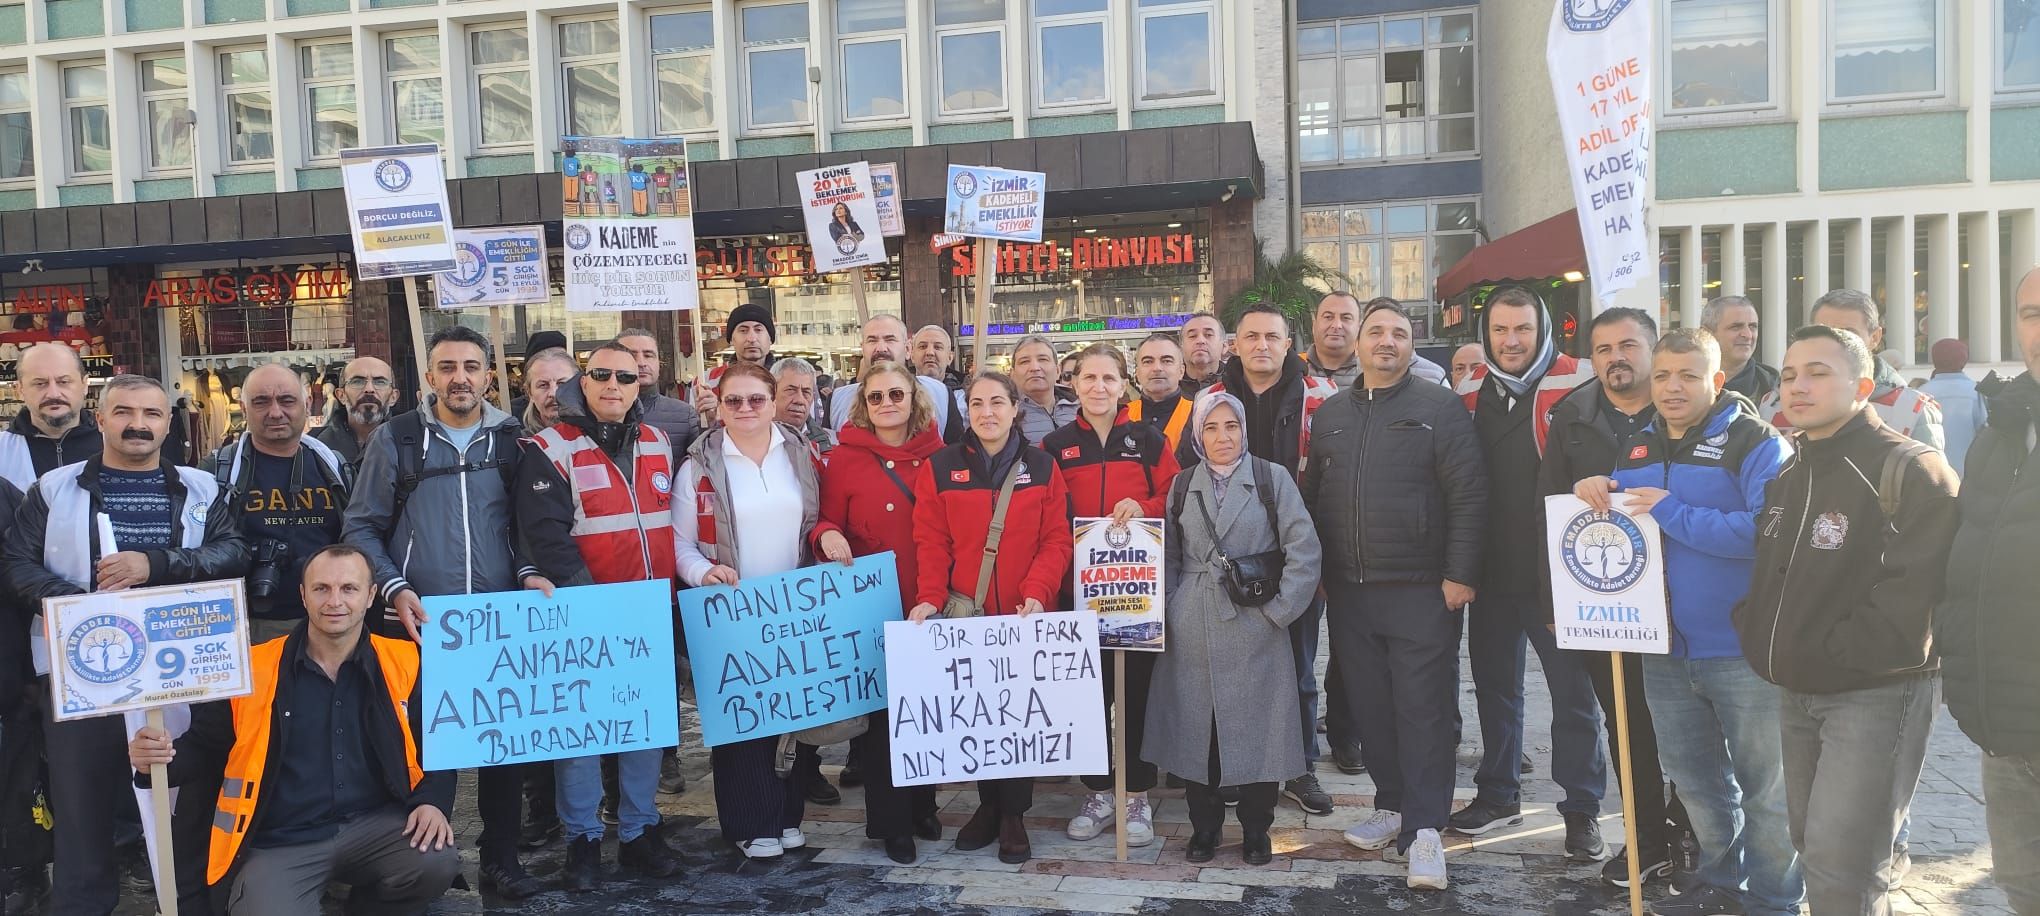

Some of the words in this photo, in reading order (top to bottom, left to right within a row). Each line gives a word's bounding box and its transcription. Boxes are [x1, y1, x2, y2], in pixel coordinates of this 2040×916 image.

[1577, 81, 1585, 96] 1
[1591, 57, 1640, 91] GÜNE
[1590, 99, 1608, 118] 17
[1613, 87, 1639, 109] YIL
[1579, 124, 1621, 155] ADİL
[814, 172, 820, 180] 1
[822, 167, 851, 179] GÜNE
[1584, 148, 1634, 184] KADE
[813, 180, 831, 192] 20
[833, 176, 856, 188] YIL
[816, 186, 858, 199] BEKLEMEK
[991, 176, 1029, 192] İZMİR
[363, 213, 398, 222] BORÇLU
[400, 209, 436, 219] DEĞİLİZ,
[978, 205, 1038, 222] EMEKLİLİK
[995, 219, 1034, 232] İSTİYOR!
[1604, 213, 1632, 236] HA
[376, 232, 431, 243] ALACAKLIYIZ
[599, 226, 659, 249] KADEME
[1073, 234, 1194, 269] DÜNYASI
[493, 266, 510, 287] 5
[514, 265, 535, 273] SGK
[571, 271, 600, 287] HİÇ
[604, 271, 632, 284] BİR
[636, 269, 691, 284] SORUN
[15, 284, 86, 312] ALTIN
[144, 275, 238, 308] ARAS
[599, 284, 666, 297] YOKTUR
[264, 517, 286, 525] NEW
[289, 516, 324, 525] AVEN
[1565, 511, 1610, 549] EMADDER
[1616, 515, 1643, 549] İZMİR
[1089, 547, 1148, 566] İZMİR
[1080, 566, 1157, 585] KADEME
[1083, 581, 1157, 598] İSTİYOR!
[159, 610, 168, 618] 9
[171, 606, 198, 617] GÜN
[202, 603, 221, 613] İLE
[1577, 600, 1640, 623] İZMİR
[151, 613, 232, 631] EMEKLİLİĞİM
[175, 625, 212, 638] GİTTİ!
[761, 613, 832, 643] GELDİK
[67, 616, 111, 651] EMADDER
[928, 622, 973, 651] BİR
[984, 621, 1021, 647] GÜN
[1035, 618, 1082, 643] FARK
[1563, 625, 1659, 641] TEMSİLCİLİĞİ
[194, 641, 228, 655] SGK
[155, 647, 185, 680] 9
[191, 653, 232, 665] GİRİŞİM
[718, 629, 861, 695] ADALET
[188, 667, 200, 675] 17
[202, 663, 236, 674] EYLÜL
[194, 671, 231, 685] 1999
[945, 657, 973, 691] 17
[988, 656, 1019, 683] YIL
[1033, 647, 1097, 682] CEZA
[161, 680, 184, 690] GÜN
[144, 692, 168, 702] Murat
[428, 679, 591, 734] ADALET
[723, 666, 883, 735] BİRLEŞTİK
[894, 686, 1053, 739] ANKARA
[477, 709, 651, 764] BURADAYIZ!
[902, 748, 947, 780] DUY
[959, 721, 1073, 775] SESİMİZİ
